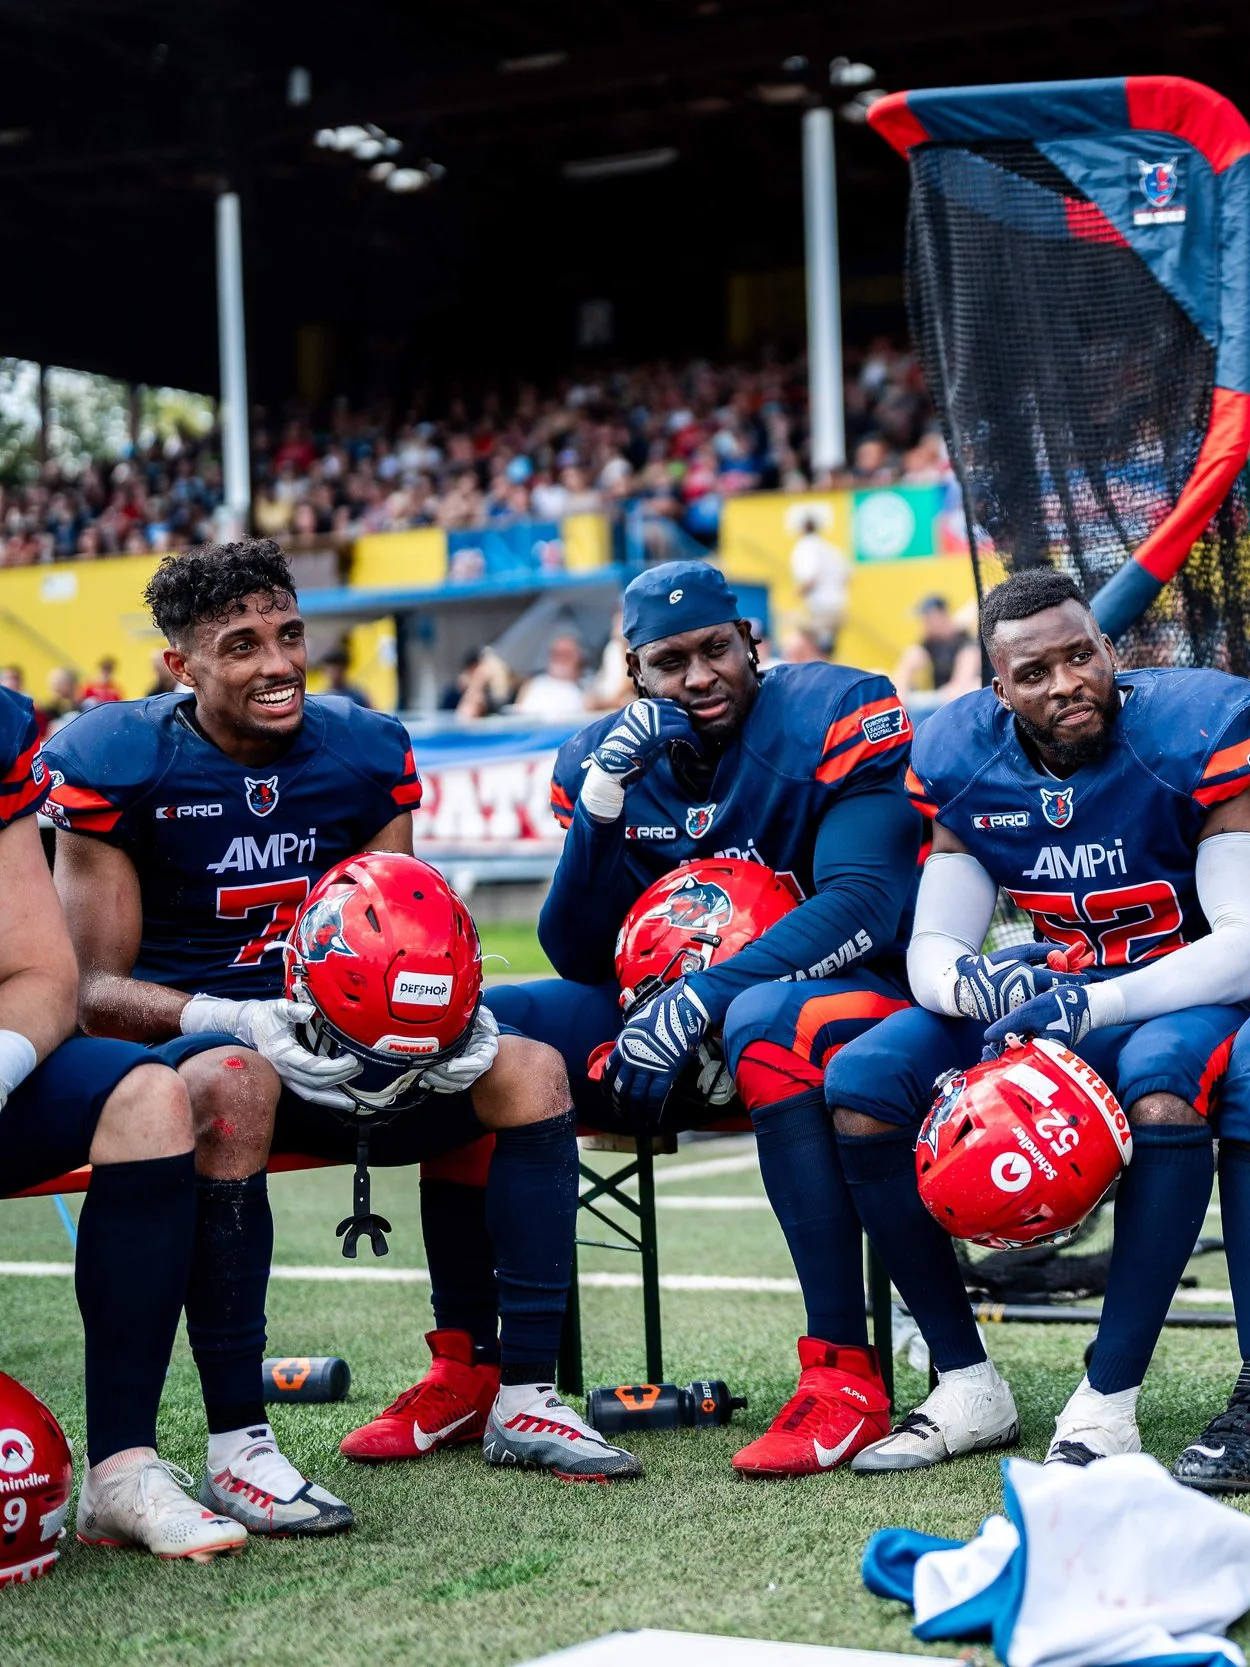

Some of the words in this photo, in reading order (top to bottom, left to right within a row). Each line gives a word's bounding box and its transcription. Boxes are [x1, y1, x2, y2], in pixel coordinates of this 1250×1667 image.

[207, 827, 317, 874] AMPri
[1022, 838, 1128, 880] AMPri
[215, 875, 311, 968] 7
[1003, 880, 1188, 966] 52
[1057, 1049, 1133, 1148] FORELLE
[1035, 1107, 1080, 1157] 52
[840, 1386, 868, 1405] ALPHA
[0, 1472, 51, 1493] hindler
